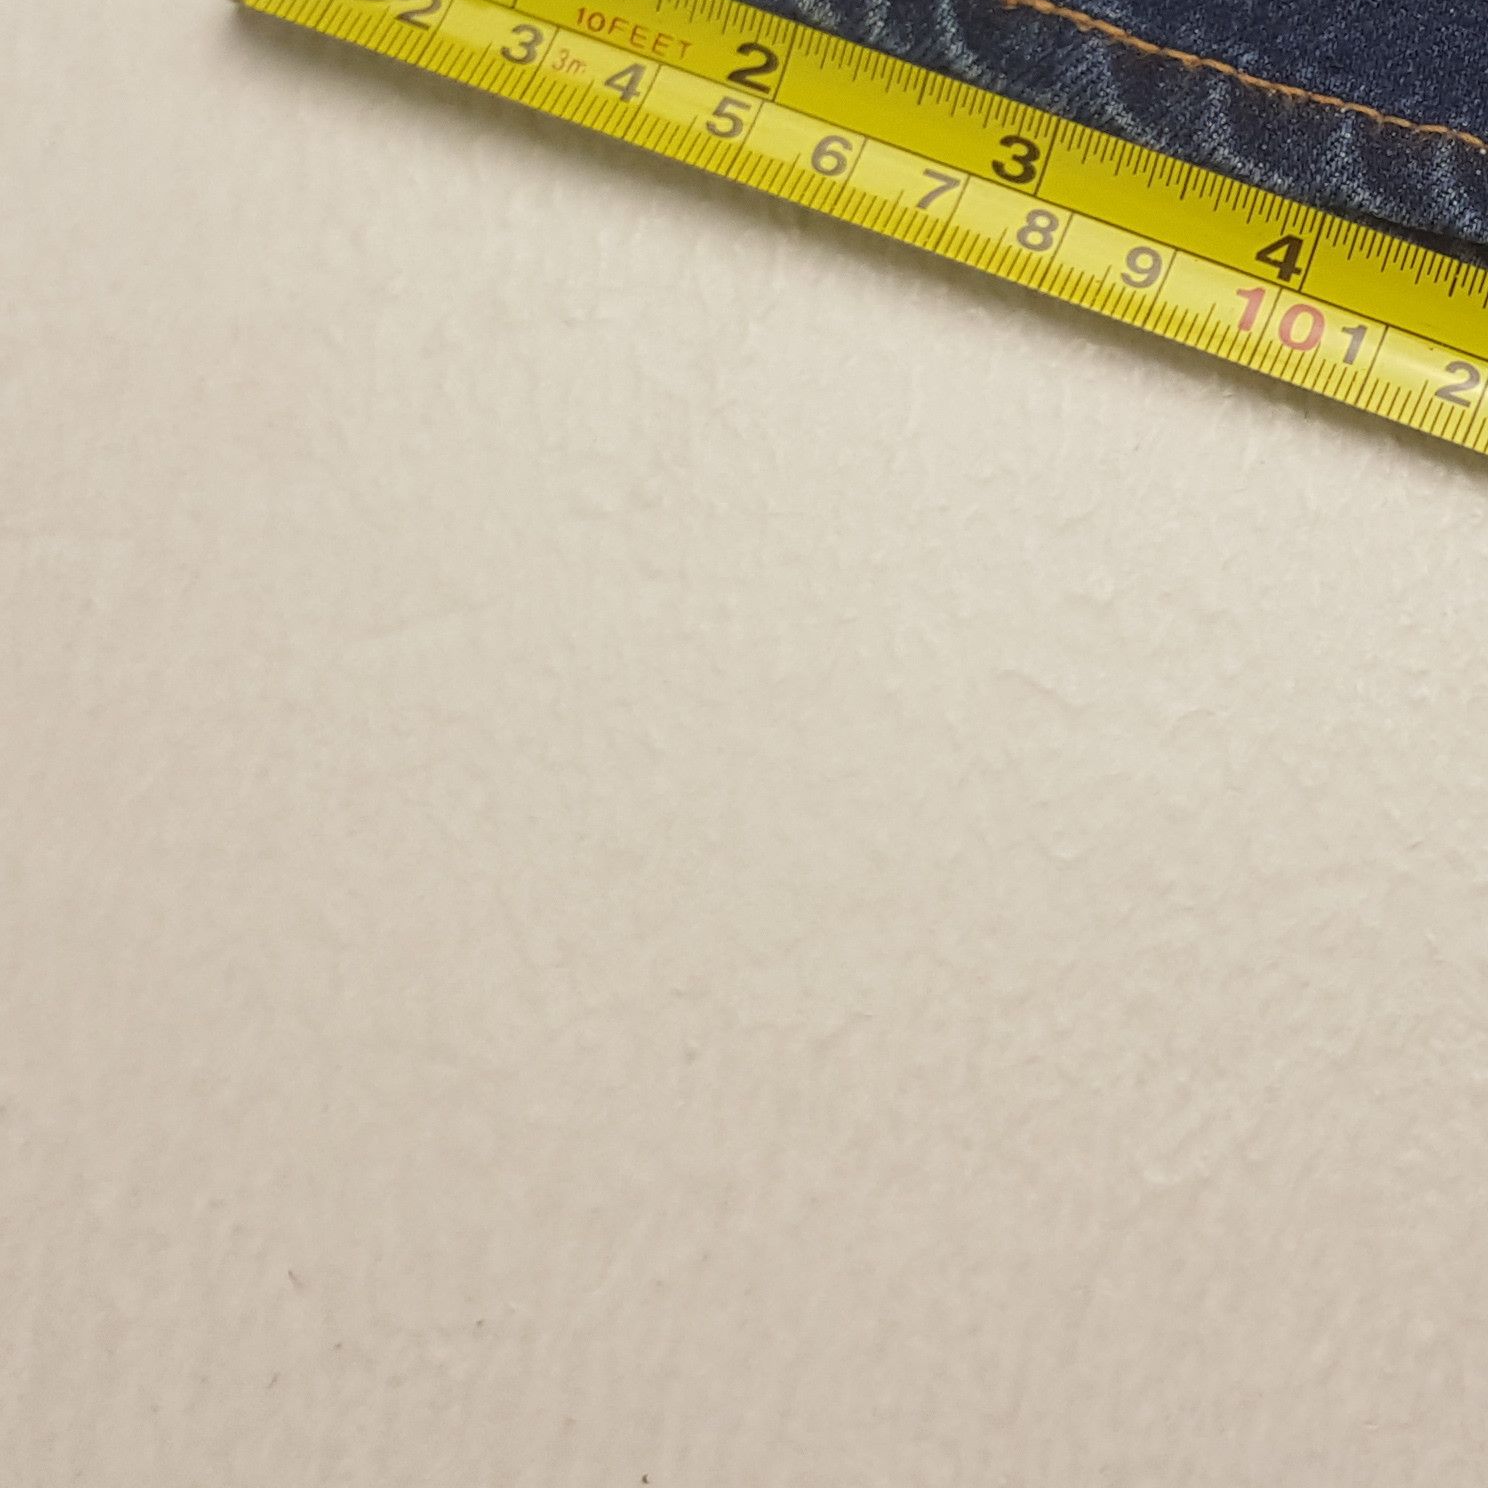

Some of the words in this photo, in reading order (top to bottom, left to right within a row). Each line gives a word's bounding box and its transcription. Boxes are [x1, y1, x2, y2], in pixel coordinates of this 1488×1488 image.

[501, 24, 544, 65] 3
[605, 64, 647, 102] 4
[706, 96, 752, 138] 5
[810, 135, 853, 176] 6
[915, 169, 960, 210] 7
[1016, 209, 1059, 251] 8
[1121, 247, 1163, 288] 9
[1235, 287, 1325, 351] 10
[1341, 325, 1368, 365] 1
[1434, 361, 1482, 407] 2
[727, 42, 780, 94] 2
[991, 135, 1041, 185] 3
[1255, 234, 1304, 281] 4
